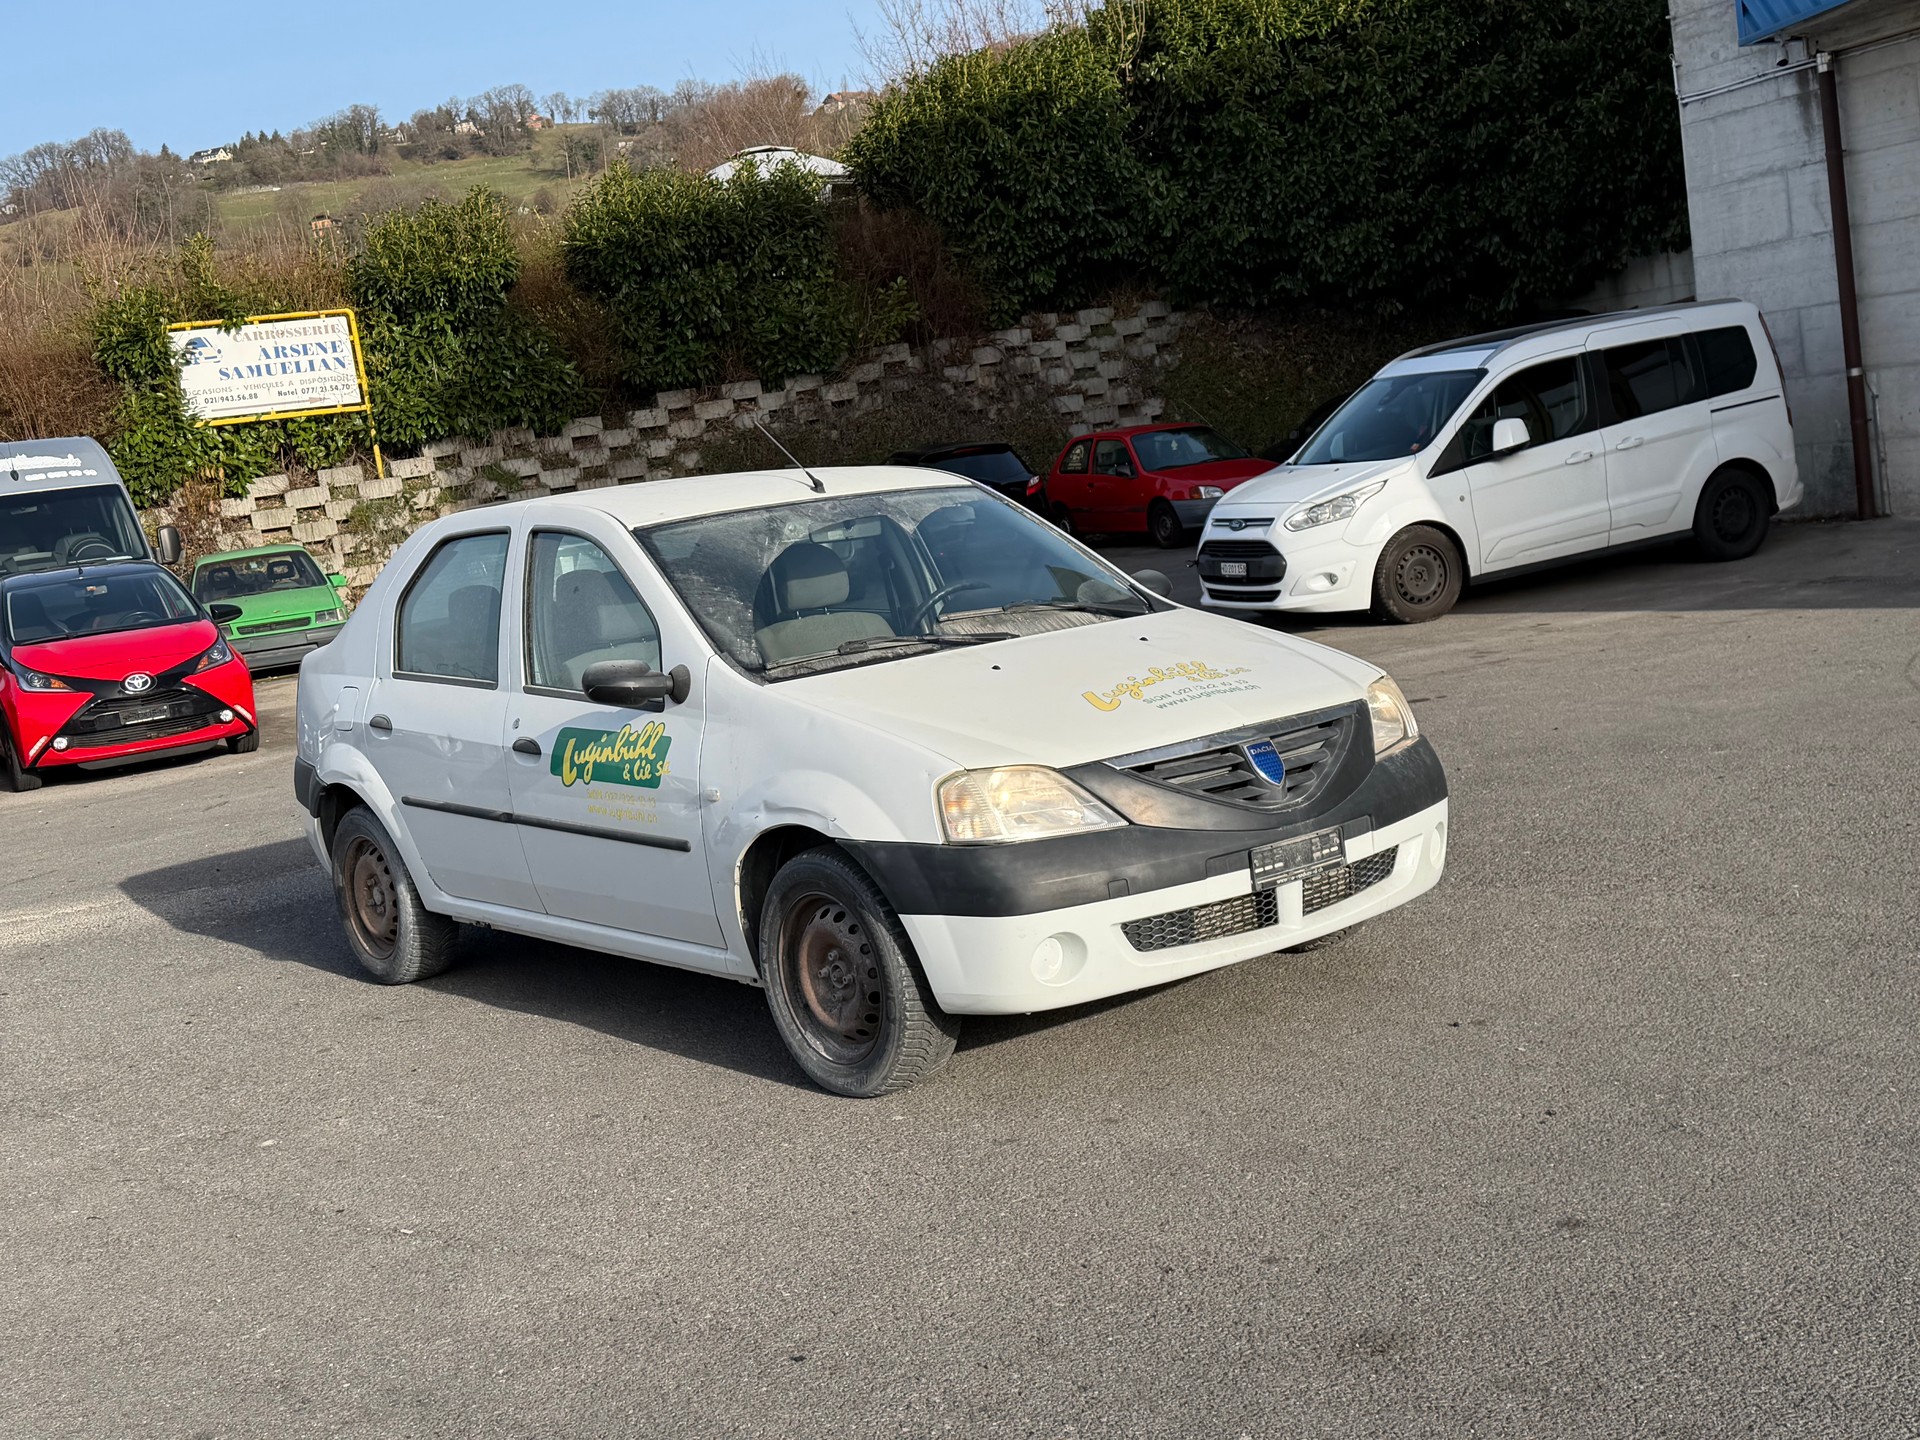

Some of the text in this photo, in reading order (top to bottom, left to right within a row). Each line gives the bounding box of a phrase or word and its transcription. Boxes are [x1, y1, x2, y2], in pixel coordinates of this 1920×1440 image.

[232, 323, 341, 343] CARROSSERIE
[258, 339, 344, 361] ARSENE
[218, 355, 347, 381] SAMUELIAN
[243, 380, 284, 391] VEHICULES
[204, 392, 259, 405] 021/943.56.88
[1250, 745, 1274, 755] DACIA
